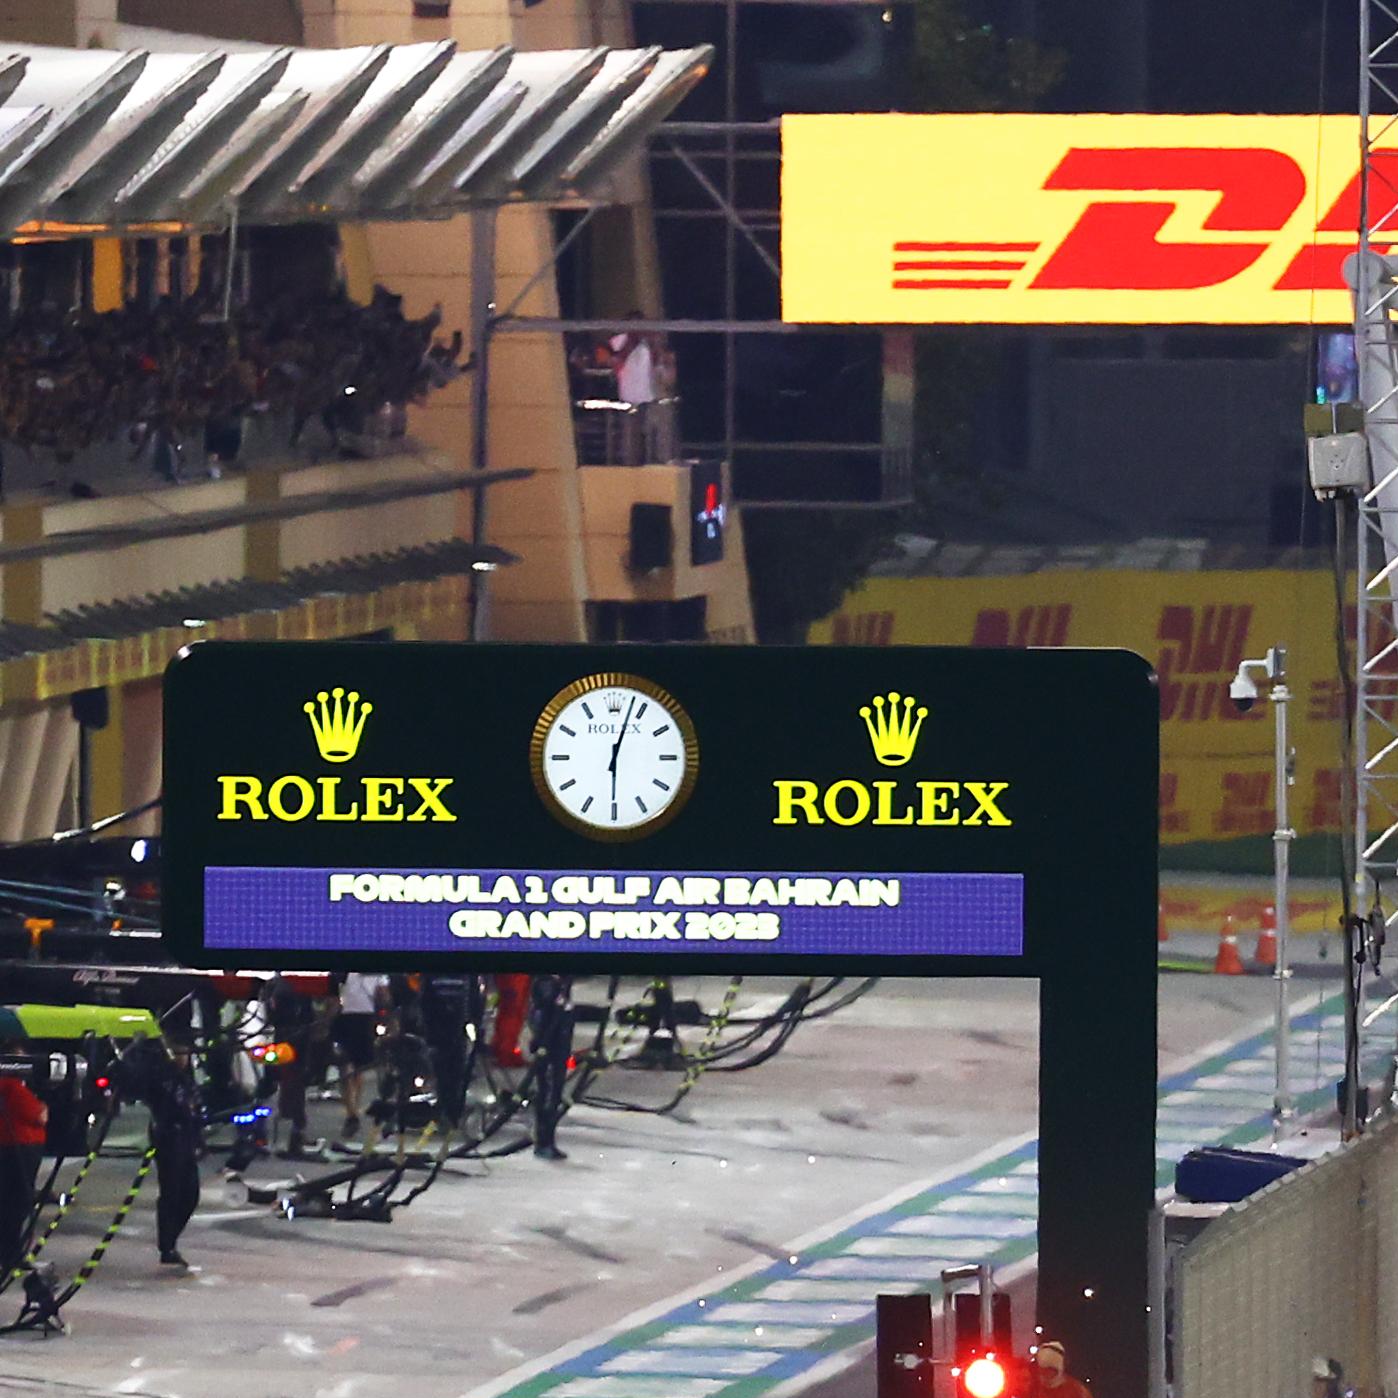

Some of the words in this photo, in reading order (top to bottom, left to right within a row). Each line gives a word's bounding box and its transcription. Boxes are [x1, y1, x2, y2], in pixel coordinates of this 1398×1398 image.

[217, 775, 457, 822] ROLEX
[773, 779, 1013, 826] ROLEX
[329, 873, 522, 903] FORMULA
[523, 875, 548, 904] 1
[551, 876, 652, 905] GULF
[653, 876, 721, 906] AIR
[724, 877, 900, 907] BAHRAIN
[449, 909, 587, 939] GRAND
[588, 911, 681, 940] PRIX
[684, 912, 781, 941] 2023
